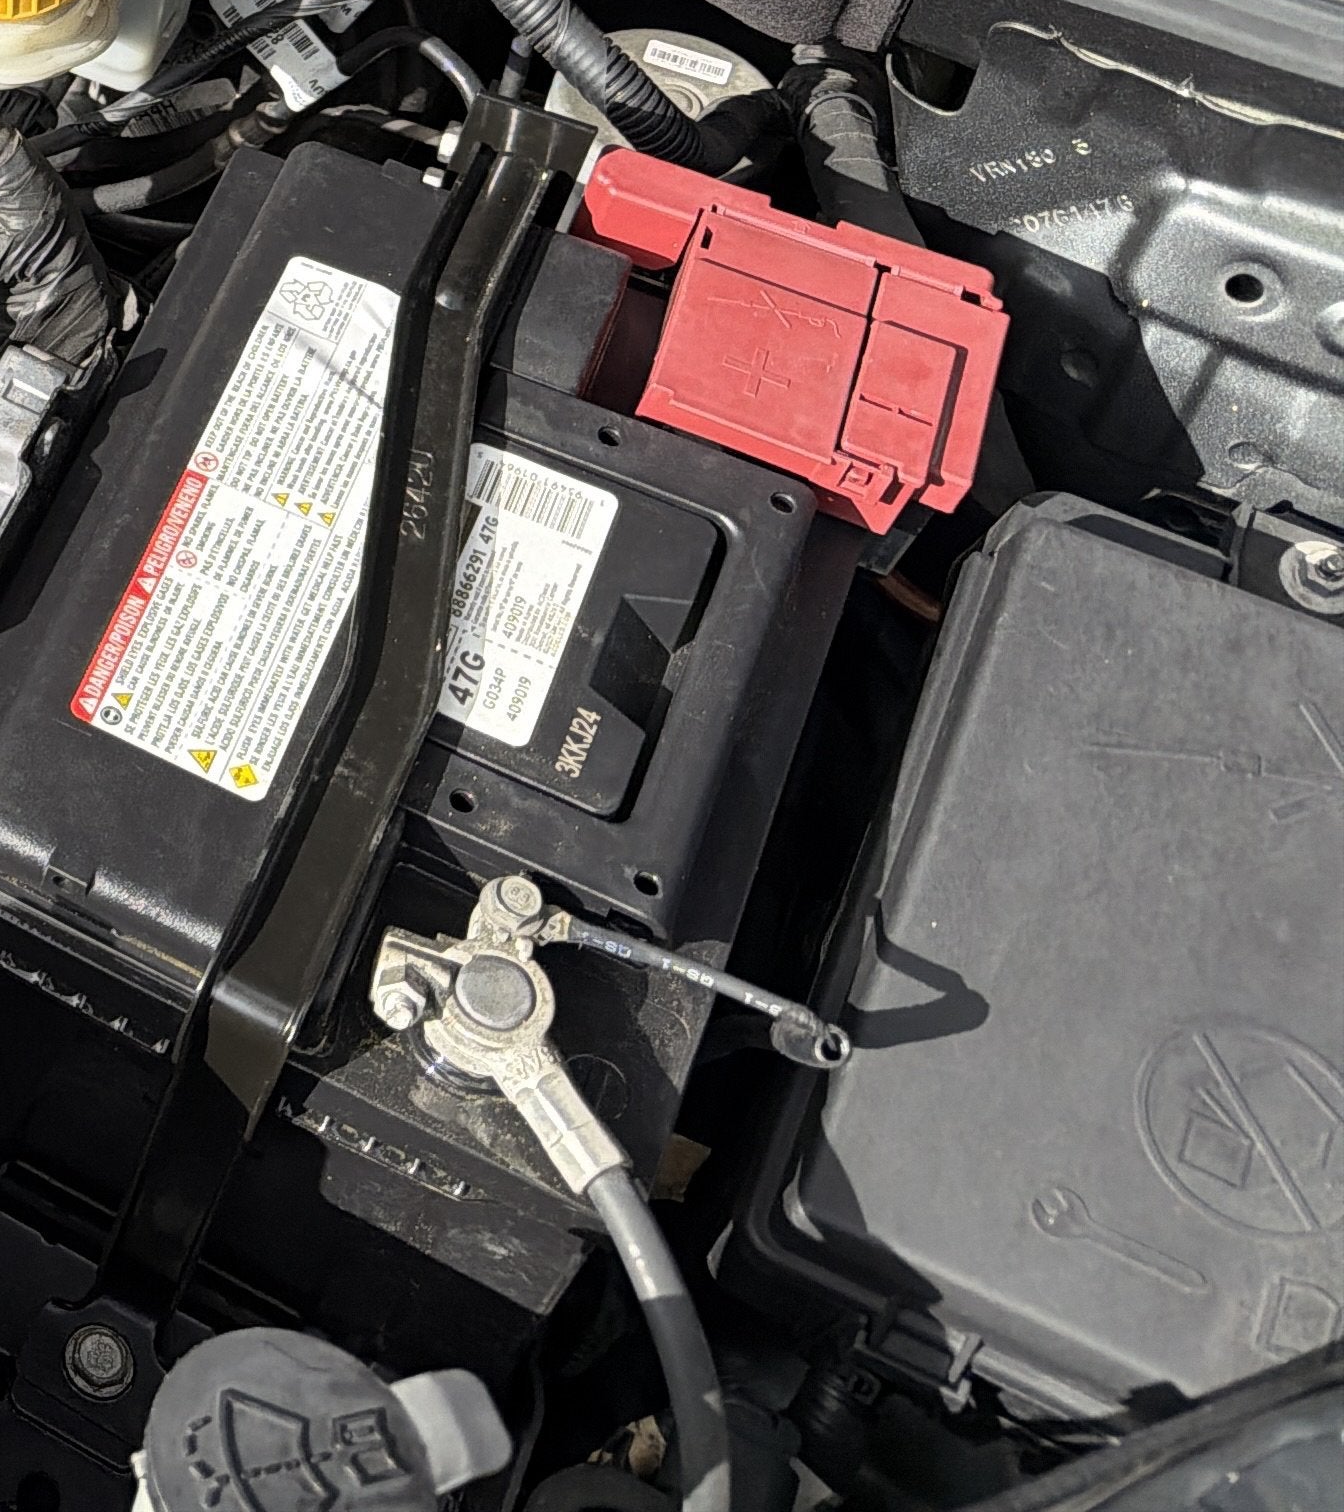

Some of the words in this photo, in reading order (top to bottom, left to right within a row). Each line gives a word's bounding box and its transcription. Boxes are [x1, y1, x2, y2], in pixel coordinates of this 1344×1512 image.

[82, 592, 146, 699] DANGER/POISON
[141, 474, 204, 578] PELIGRO/VENENO
[447, 547, 486, 619] 88866291
[476, 514, 499, 544] 47G
[501, 592, 527, 641] 409019
[445, 644, 486, 710] 47G
[482, 664, 506, 712] G034P
[505, 672, 532, 724] 409019
[552, 704, 602, 780] 3KKJ24
